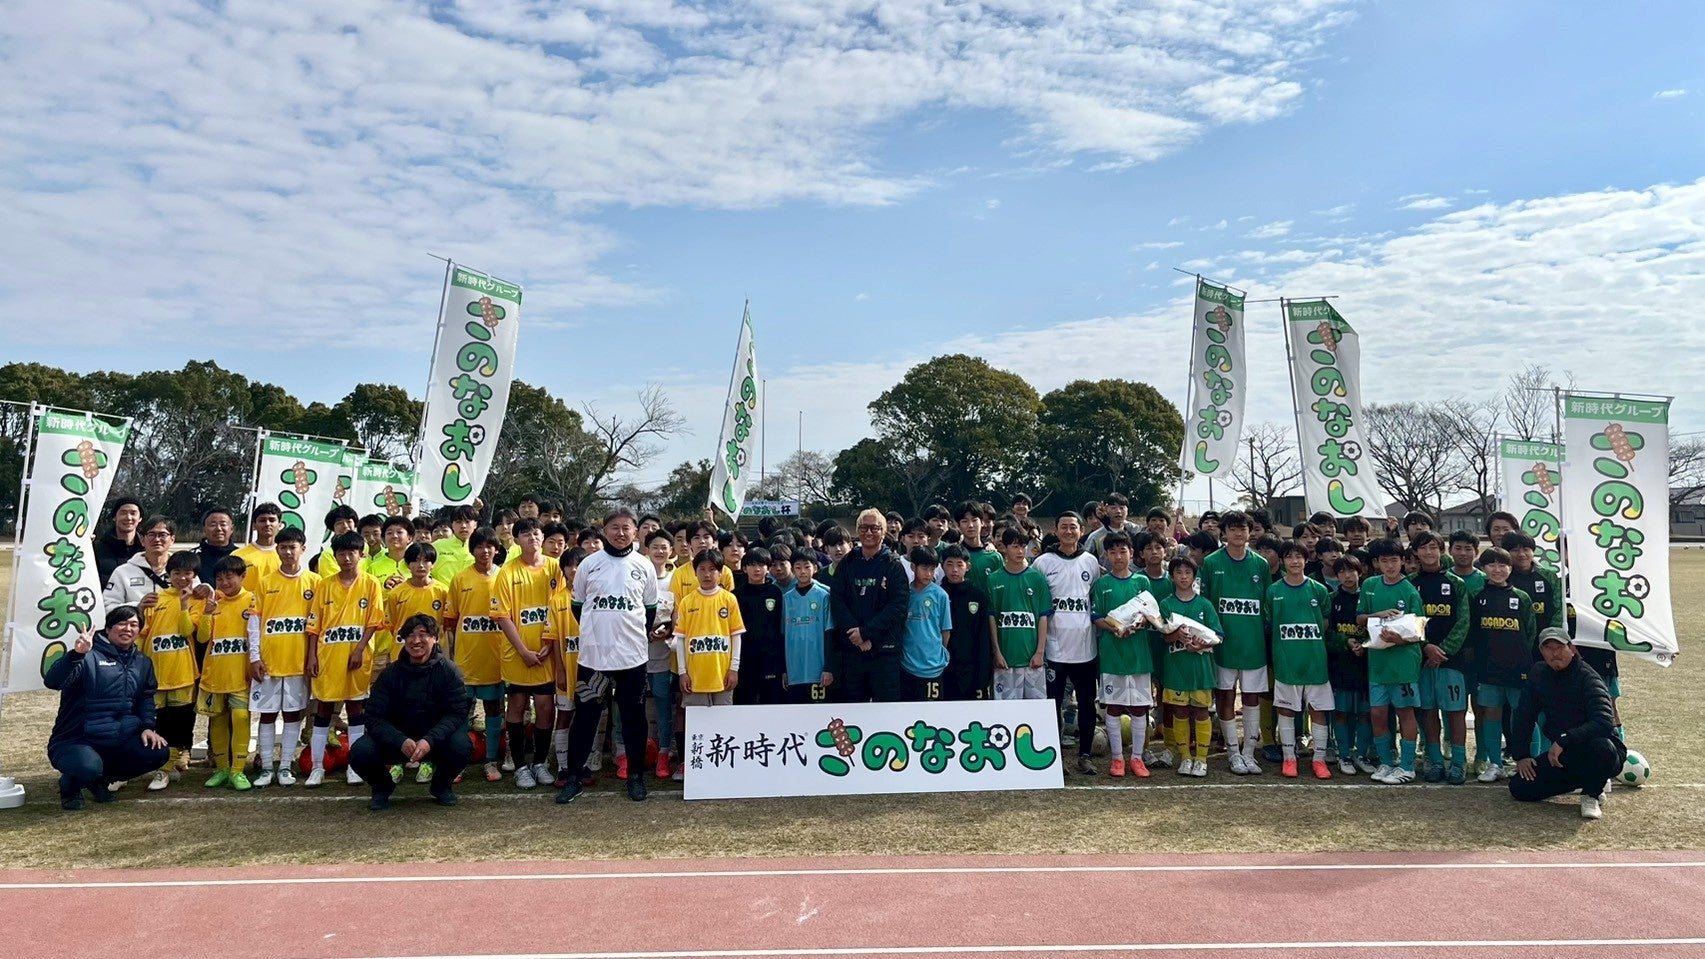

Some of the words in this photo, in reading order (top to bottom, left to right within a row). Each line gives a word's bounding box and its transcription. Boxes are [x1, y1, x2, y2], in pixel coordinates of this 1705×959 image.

[1570, 401, 1664, 418] 新時代グループ
[723, 341, 757, 514] のなおし
[269, 440, 340, 458] 新時代グループ
[1506, 443, 1565, 458] 新時代グル
[1219, 599, 1259, 614] さのなおし
[1423, 604, 1451, 615] ADOR
[690, 637, 728, 653] さのなおし
[811, 684, 826, 700] 63
[927, 682, 940, 699] 15
[1447, 684, 1460, 701] 19
[706, 733, 808, 768] 新時代
[815, 717, 1056, 777] さのなおし
